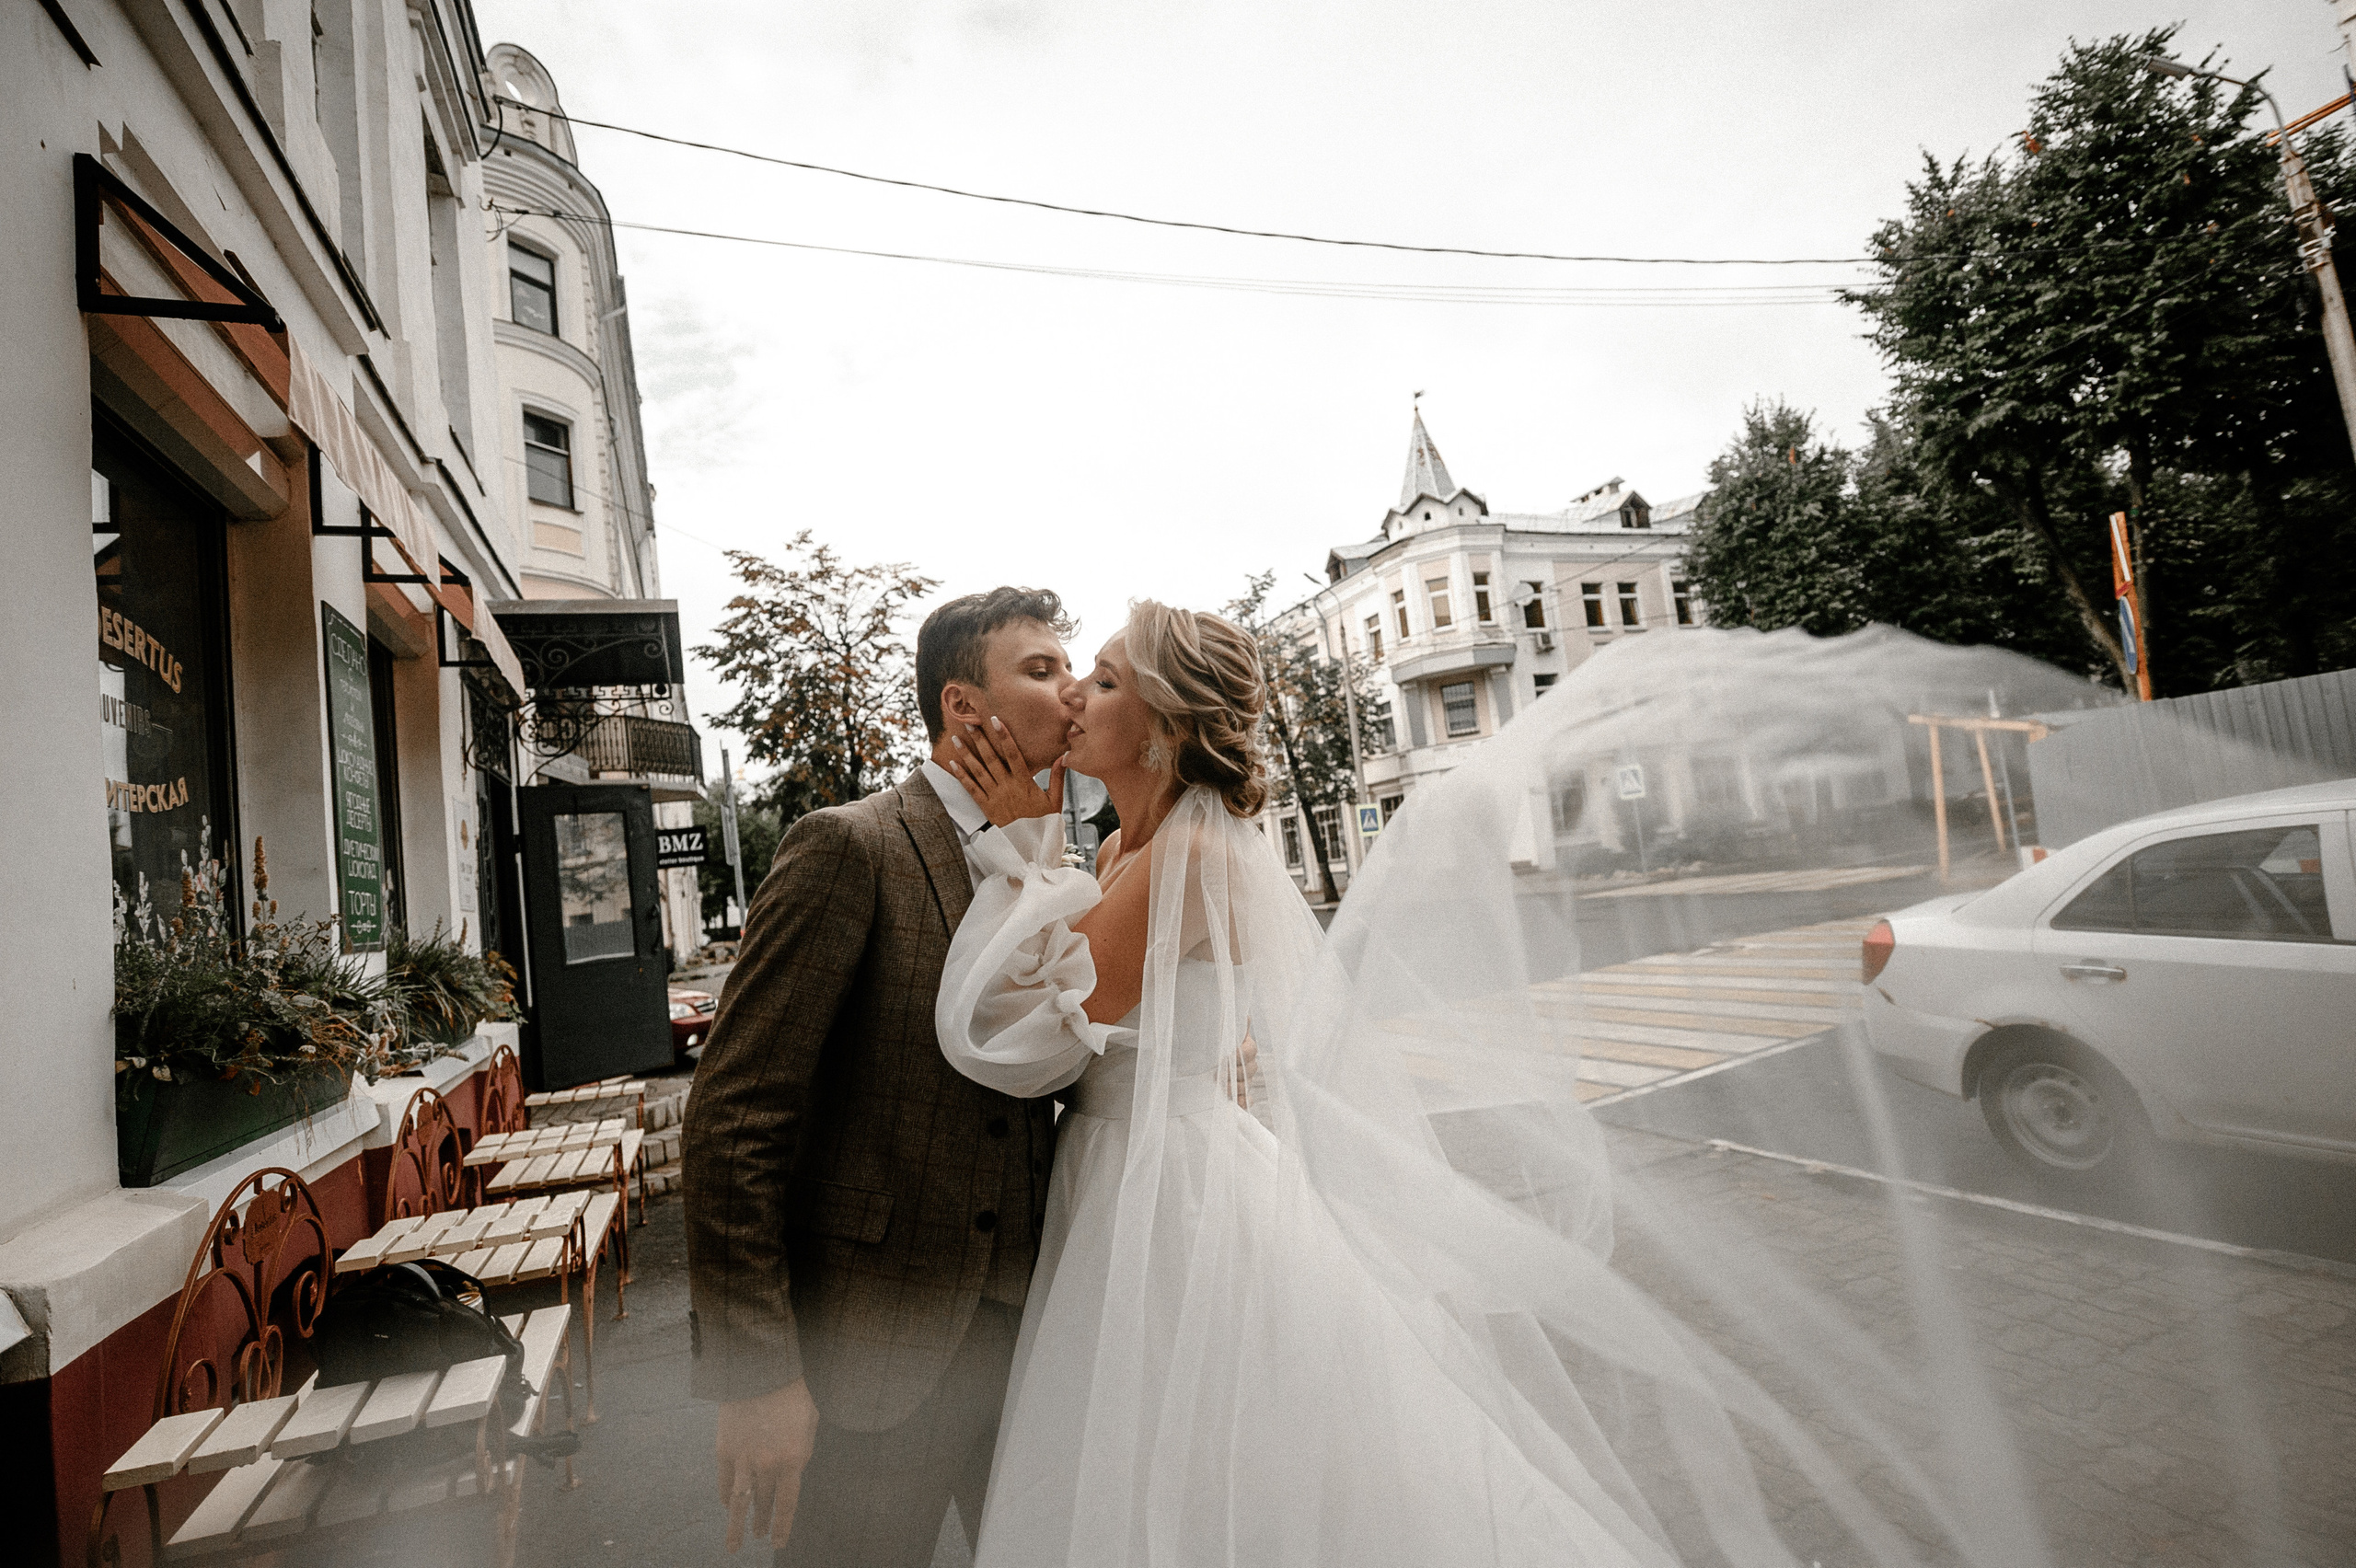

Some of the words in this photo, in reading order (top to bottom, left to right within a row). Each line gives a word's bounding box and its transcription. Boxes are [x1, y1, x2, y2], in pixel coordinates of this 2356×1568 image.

[98, 606, 183, 694] ESERTUS
[99, 693, 152, 737] UVENIRS
[658, 833, 703, 854] BMZ
[348, 890, 376, 917] ТОРТЫ
